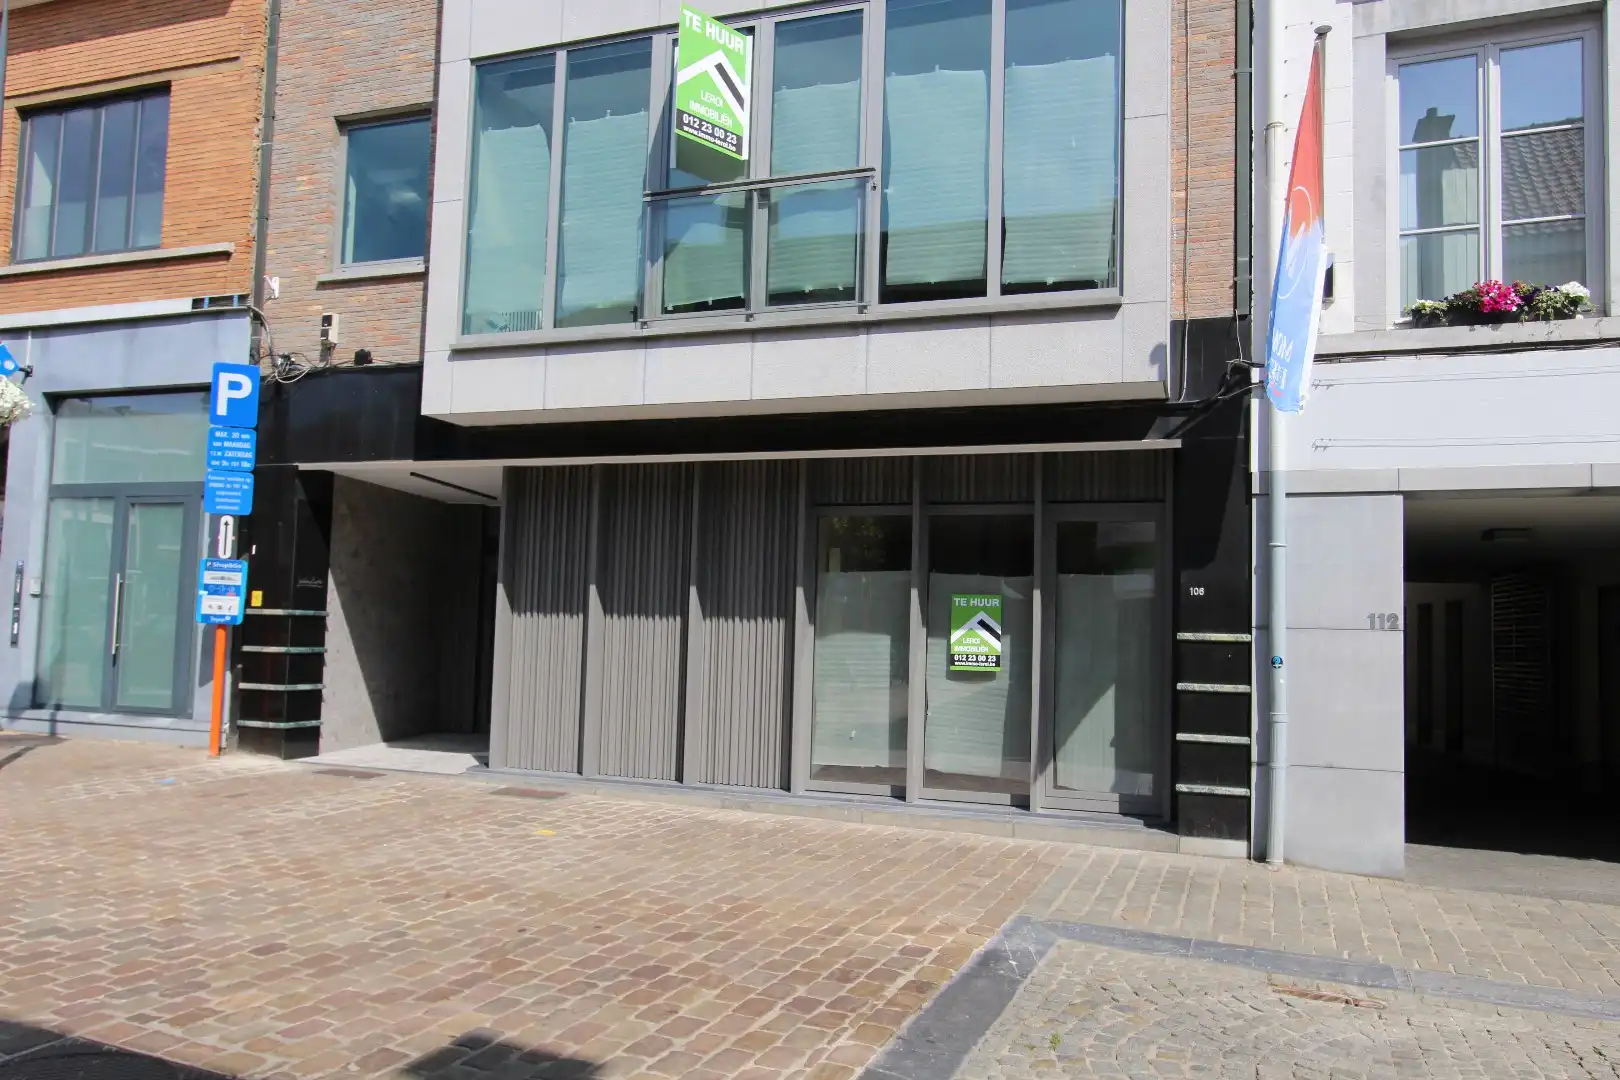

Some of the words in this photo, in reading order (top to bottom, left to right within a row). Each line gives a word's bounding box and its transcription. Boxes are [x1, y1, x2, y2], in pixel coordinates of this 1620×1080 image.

[683, 8, 702, 34] TE
[705, 20, 744, 55] HUUR
[700, 89, 724, 108] LEROI
[682, 113, 700, 130] 012
[701, 121, 713, 134] 23
[713, 126, 725, 139] 00
[726, 132, 737, 145] 23
[689, 99, 733, 129] IMMOBILIËN
[216, 372, 252, 416] P
[954, 597, 967, 606] TE
[970, 598, 1000, 607] HUUR
[1366, 612, 1399, 629] 112
